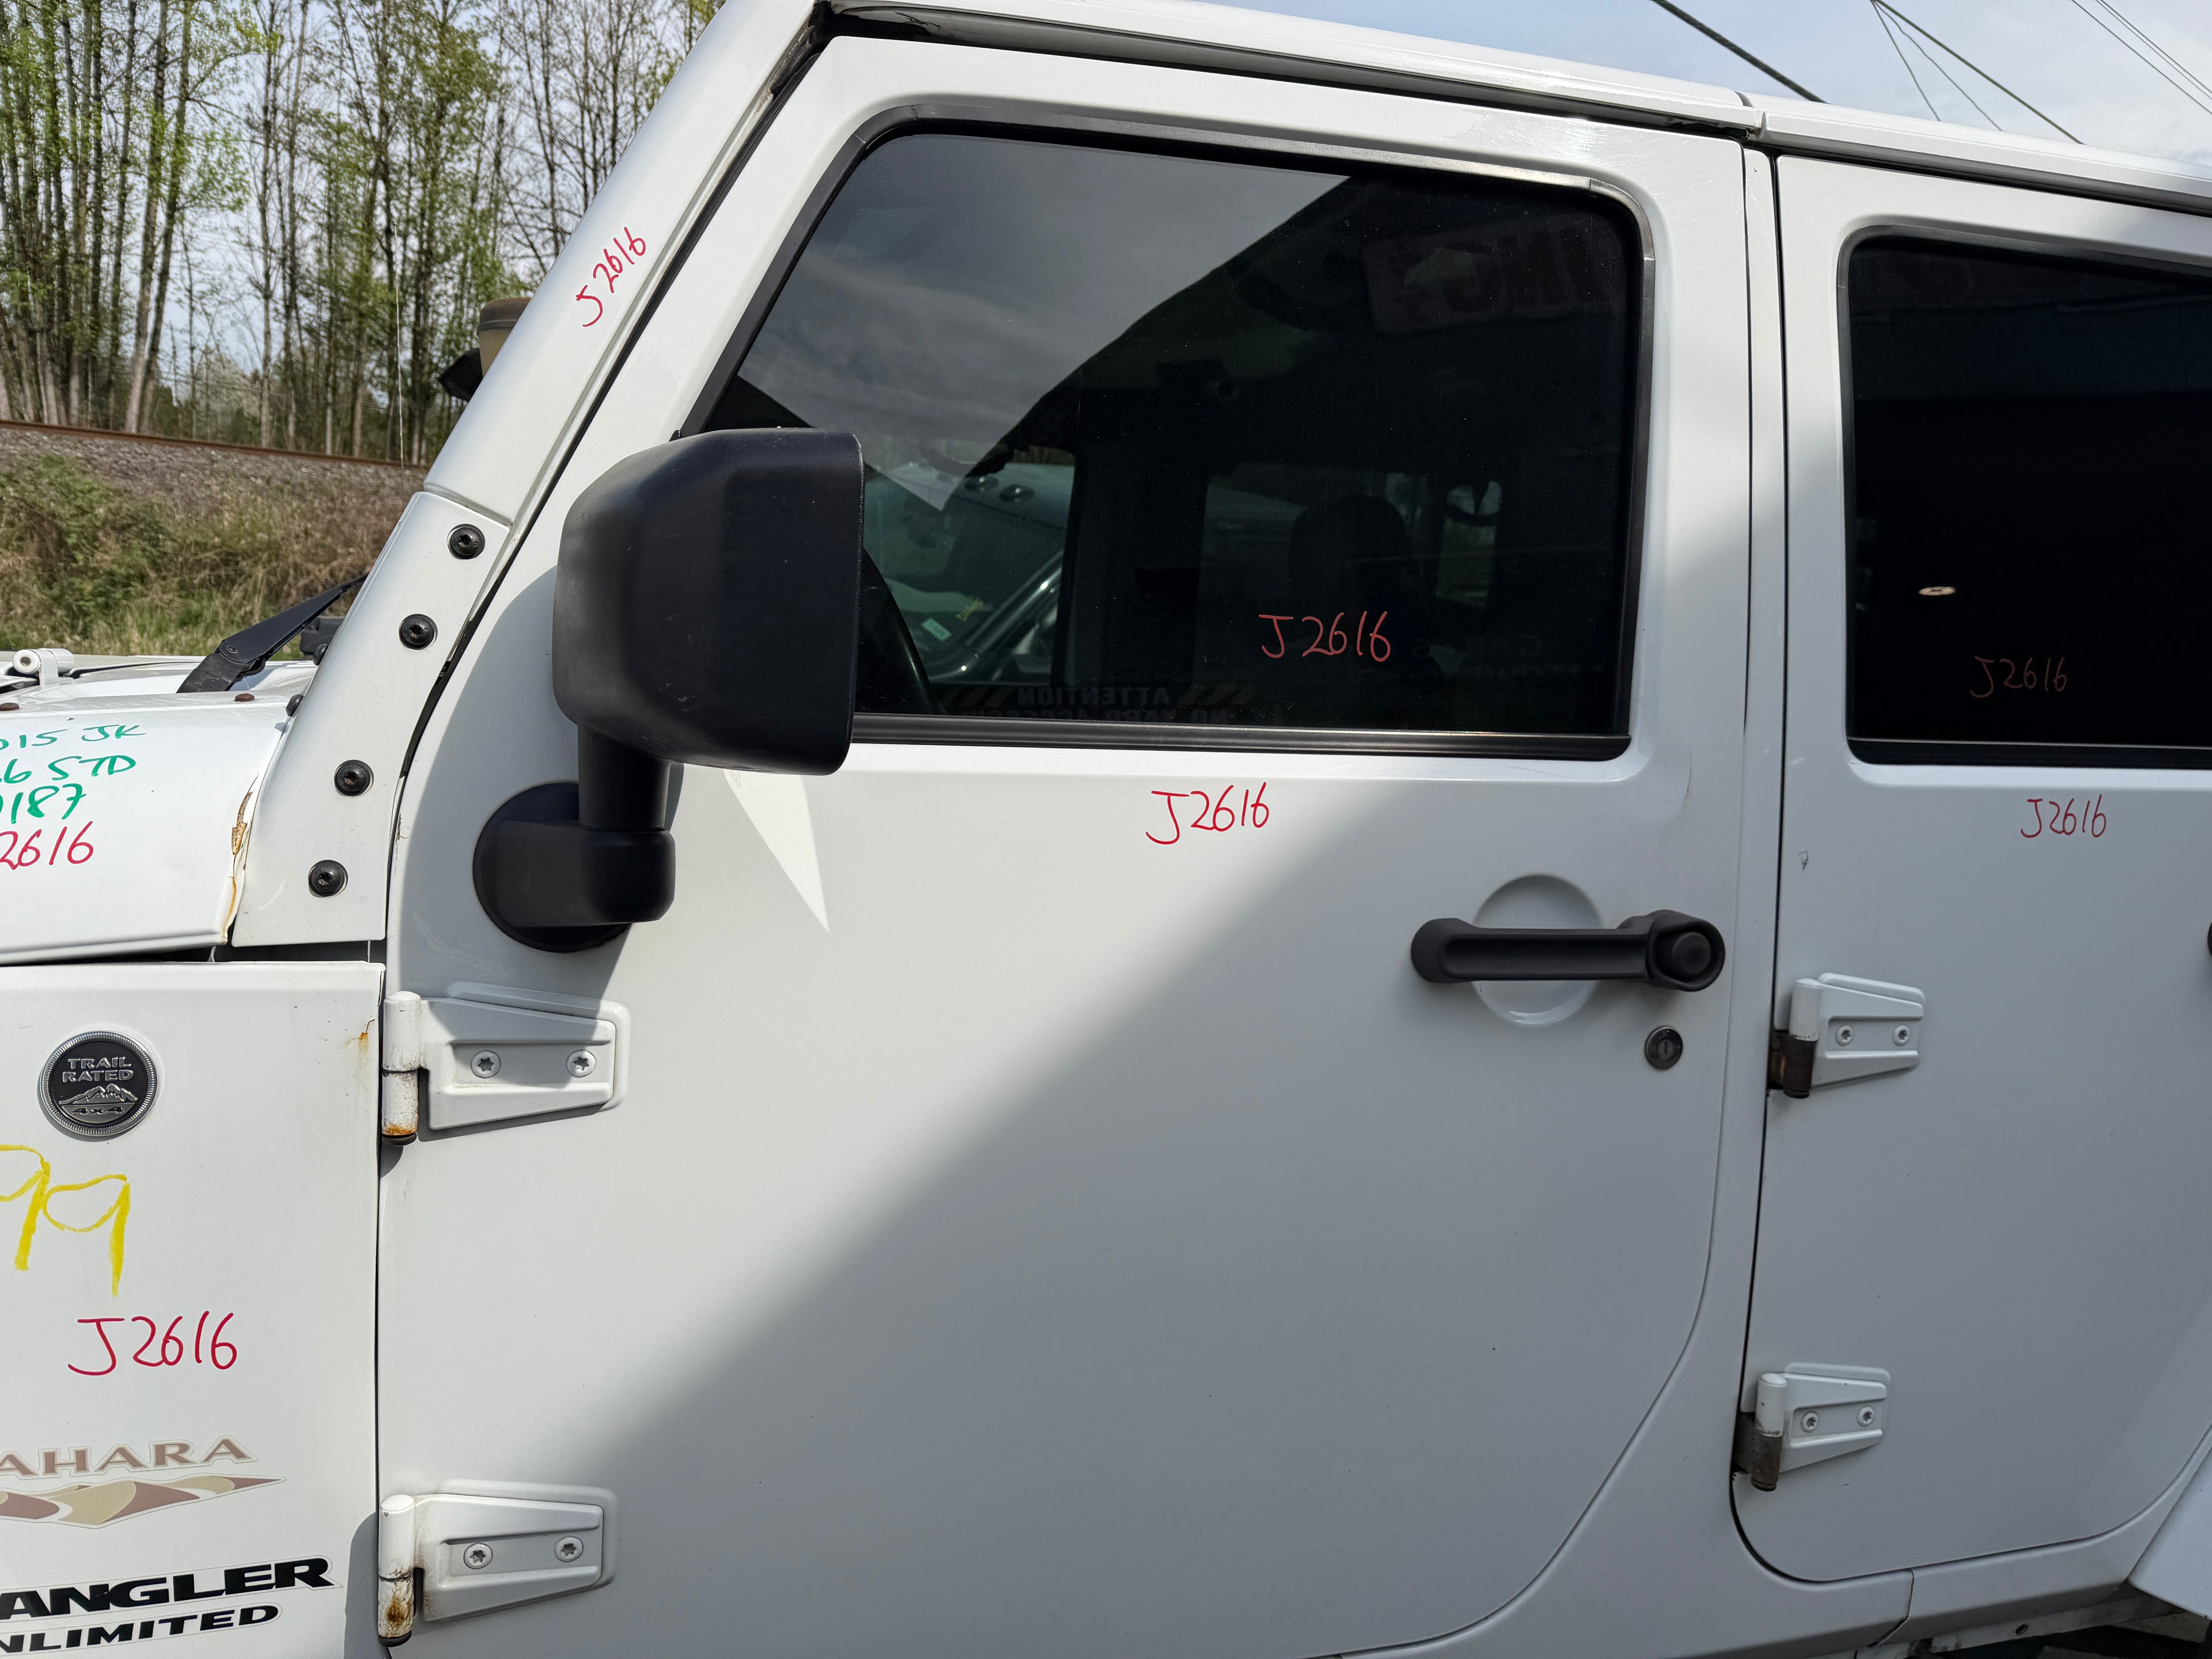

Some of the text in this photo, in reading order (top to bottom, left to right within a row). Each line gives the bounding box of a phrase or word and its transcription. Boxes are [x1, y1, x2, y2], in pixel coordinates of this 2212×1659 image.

[575, 226, 646, 327] J2616
[1259, 611, 1391, 662] J2616
[1969, 655, 2067, 698] J2616
[81, 724, 146, 742] JK
[0, 755, 137, 784] 6 STD
[0, 782, 87, 824] 187
[1146, 782, 1270, 845] J2616
[2020, 794, 2107, 838] J2616
[0, 821, 94, 870] 2616
[62, 1070, 134, 1083] RATED
[67, 1056, 132, 1070] TRAIL
[67, 1310, 237, 1376] J2616
[0, 1437, 251, 1476] AHARA
[0, 1558, 335, 1619] ANGLER
[0, 1605, 279, 1653] NLIMITED
